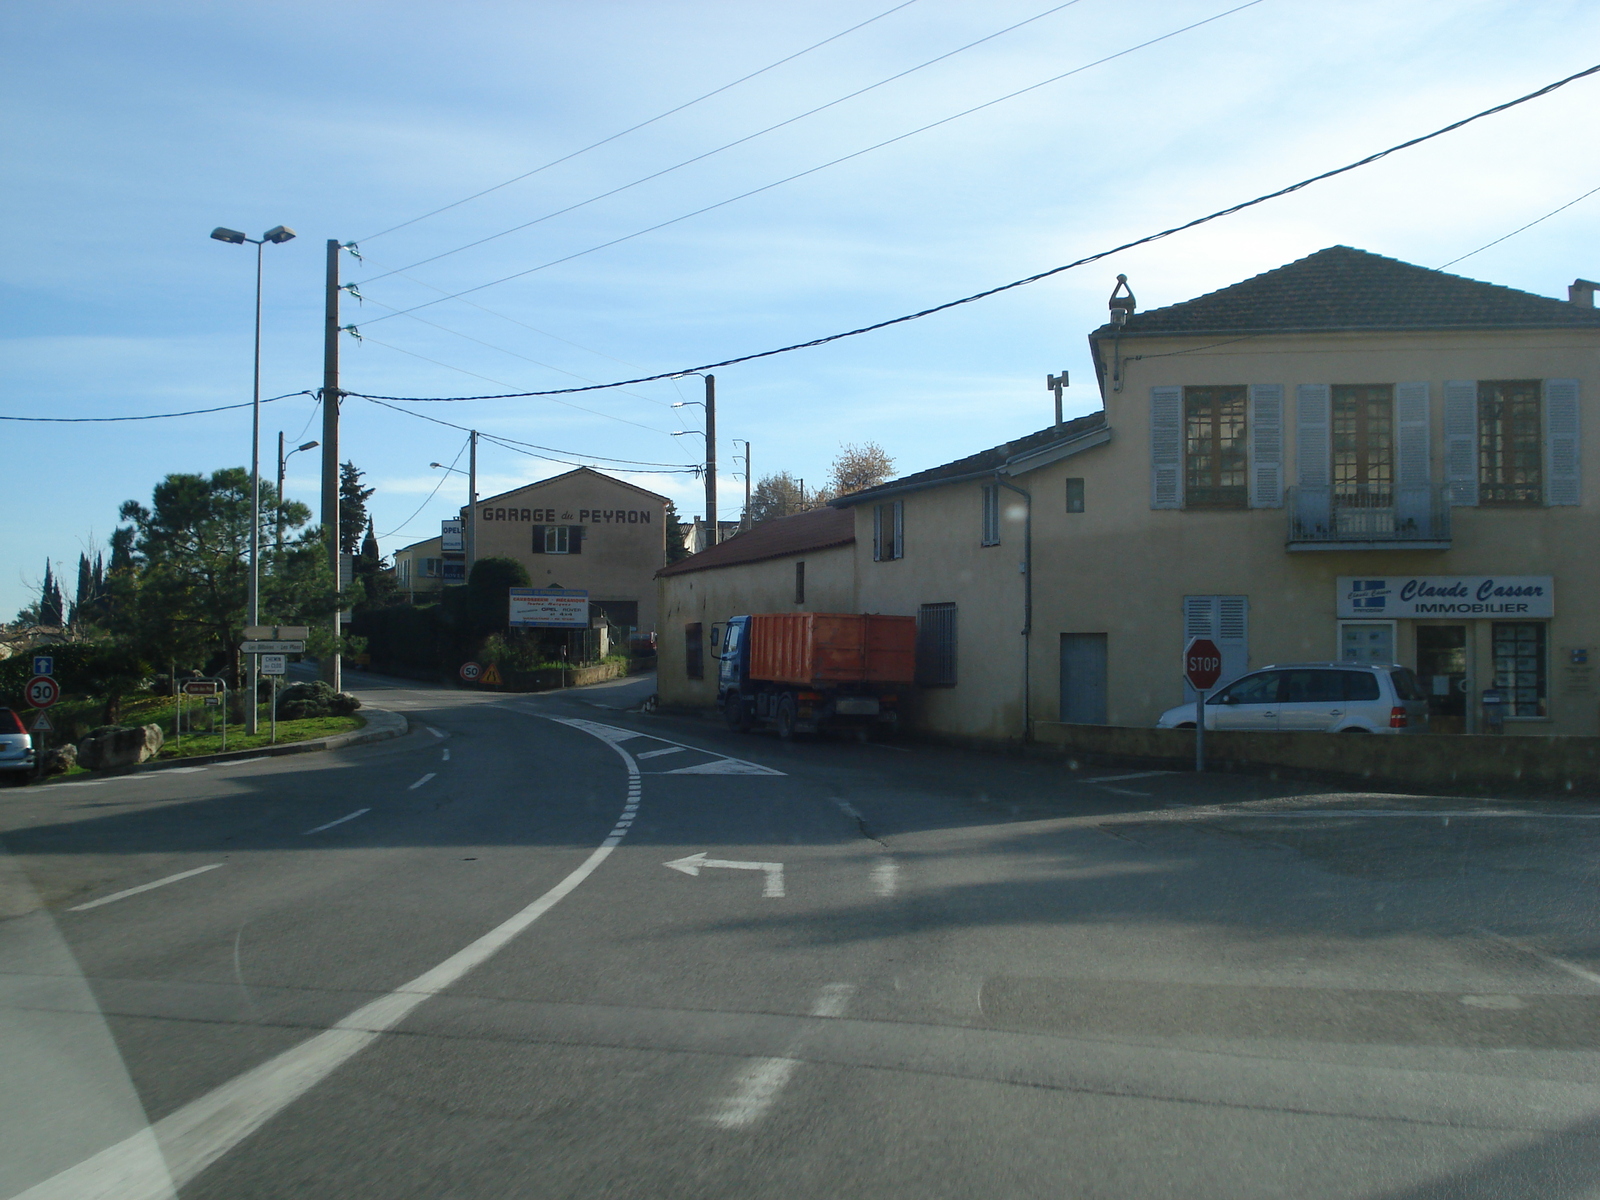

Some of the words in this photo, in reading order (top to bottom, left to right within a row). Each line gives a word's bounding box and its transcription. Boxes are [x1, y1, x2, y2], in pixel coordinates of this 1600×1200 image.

[482, 507, 556, 522] GARAGE
[561, 510, 574, 521] du
[579, 509, 651, 524] PEYRON
[443, 526, 461, 534] OPEL
[1401, 579, 1468, 602] Claude
[1476, 579, 1544, 602] Cassar
[1415, 603, 1529, 613] IMMOBILIER
[1189, 656, 1219, 672] STOP
[465, 667, 478, 676] 50
[32, 685, 52, 699] 30
